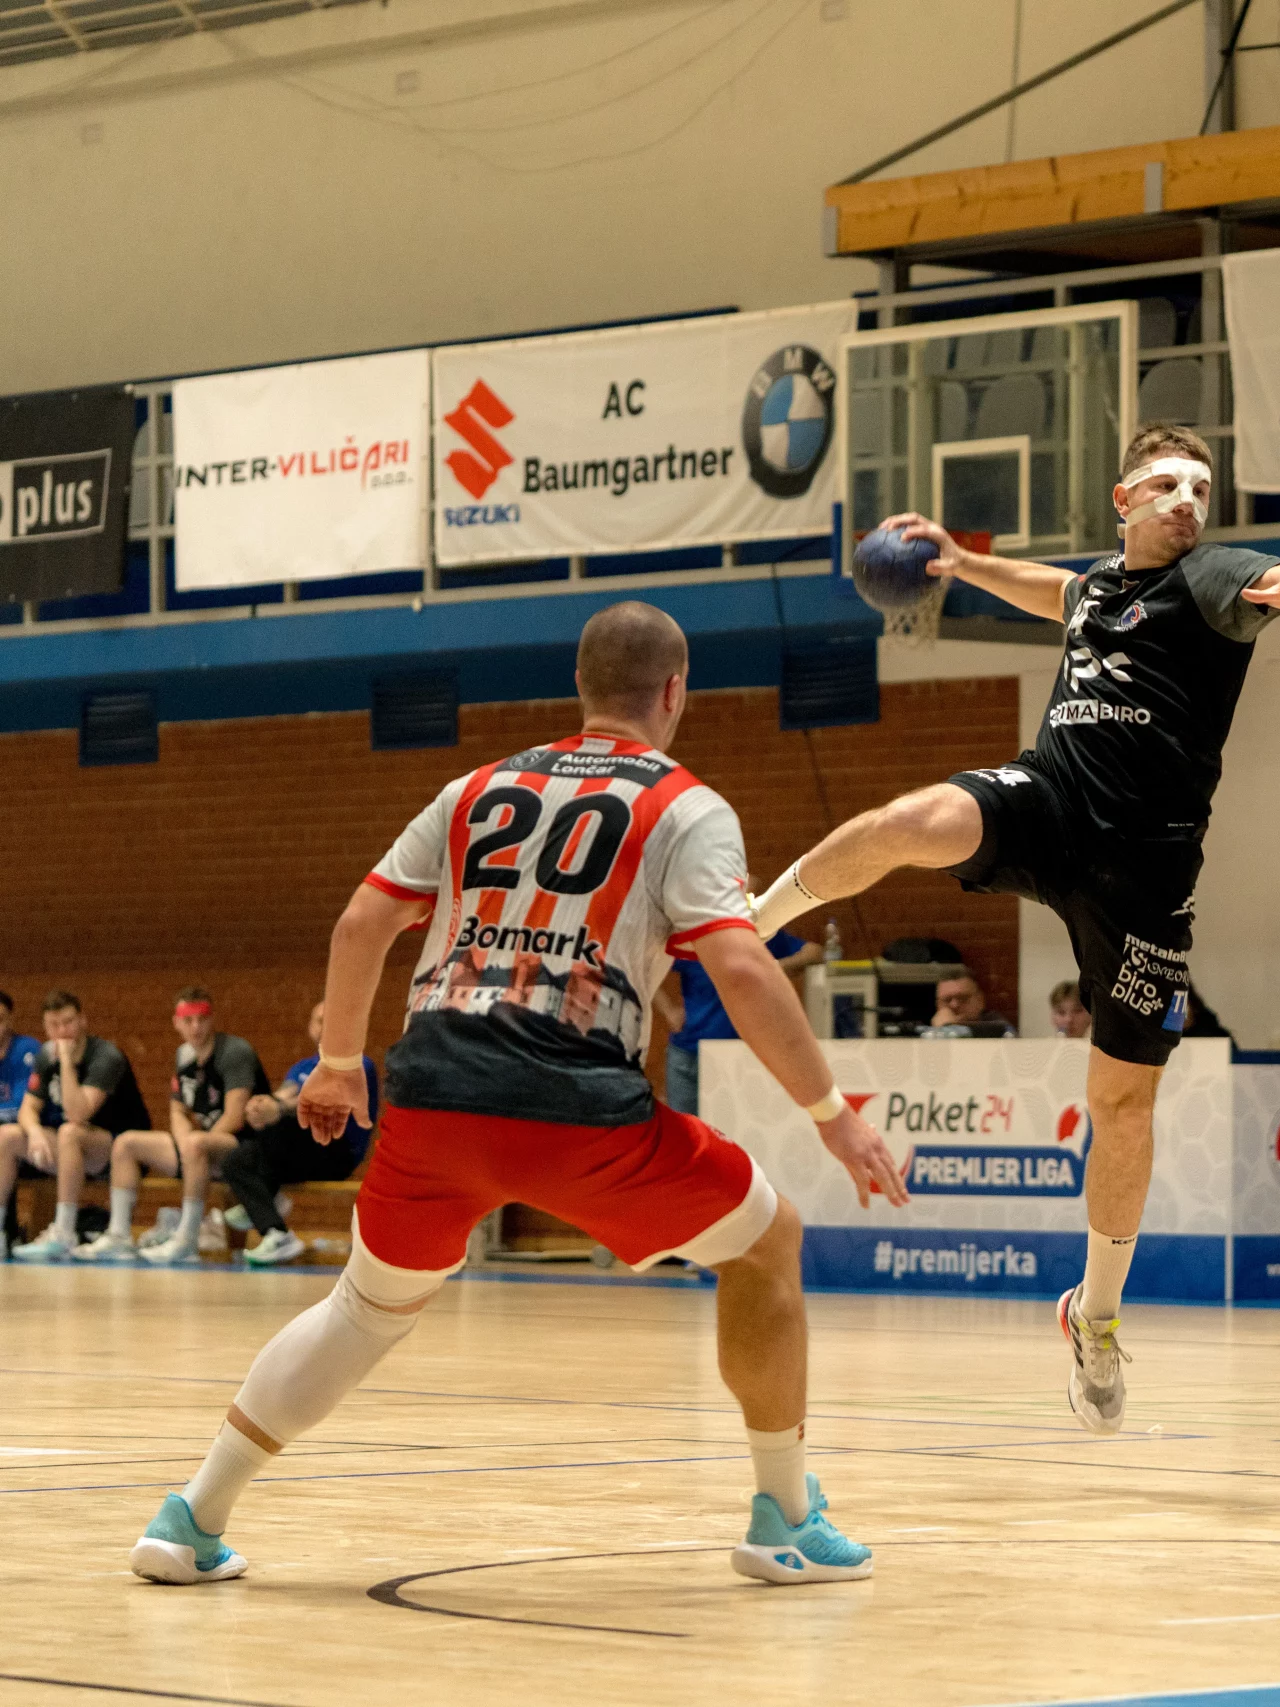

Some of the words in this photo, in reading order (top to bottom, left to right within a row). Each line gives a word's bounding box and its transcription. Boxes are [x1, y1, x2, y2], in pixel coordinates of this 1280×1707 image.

[602, 379, 646, 419] AC
[522, 444, 734, 497] Baumgartner
[16, 469, 94, 537] plus
[551, 763, 617, 775] Lončar
[558, 753, 662, 773] Automobil
[462, 785, 633, 896] 20
[456, 915, 603, 968] Bomark
[1117, 963, 1157, 998] biro
[884, 1091, 1015, 1134] Paket24
[913, 1155, 1021, 1186] PREMIJER
[1023, 1157, 1075, 1188] LIGA
[874, 1240, 1037, 1282] #premijerka
